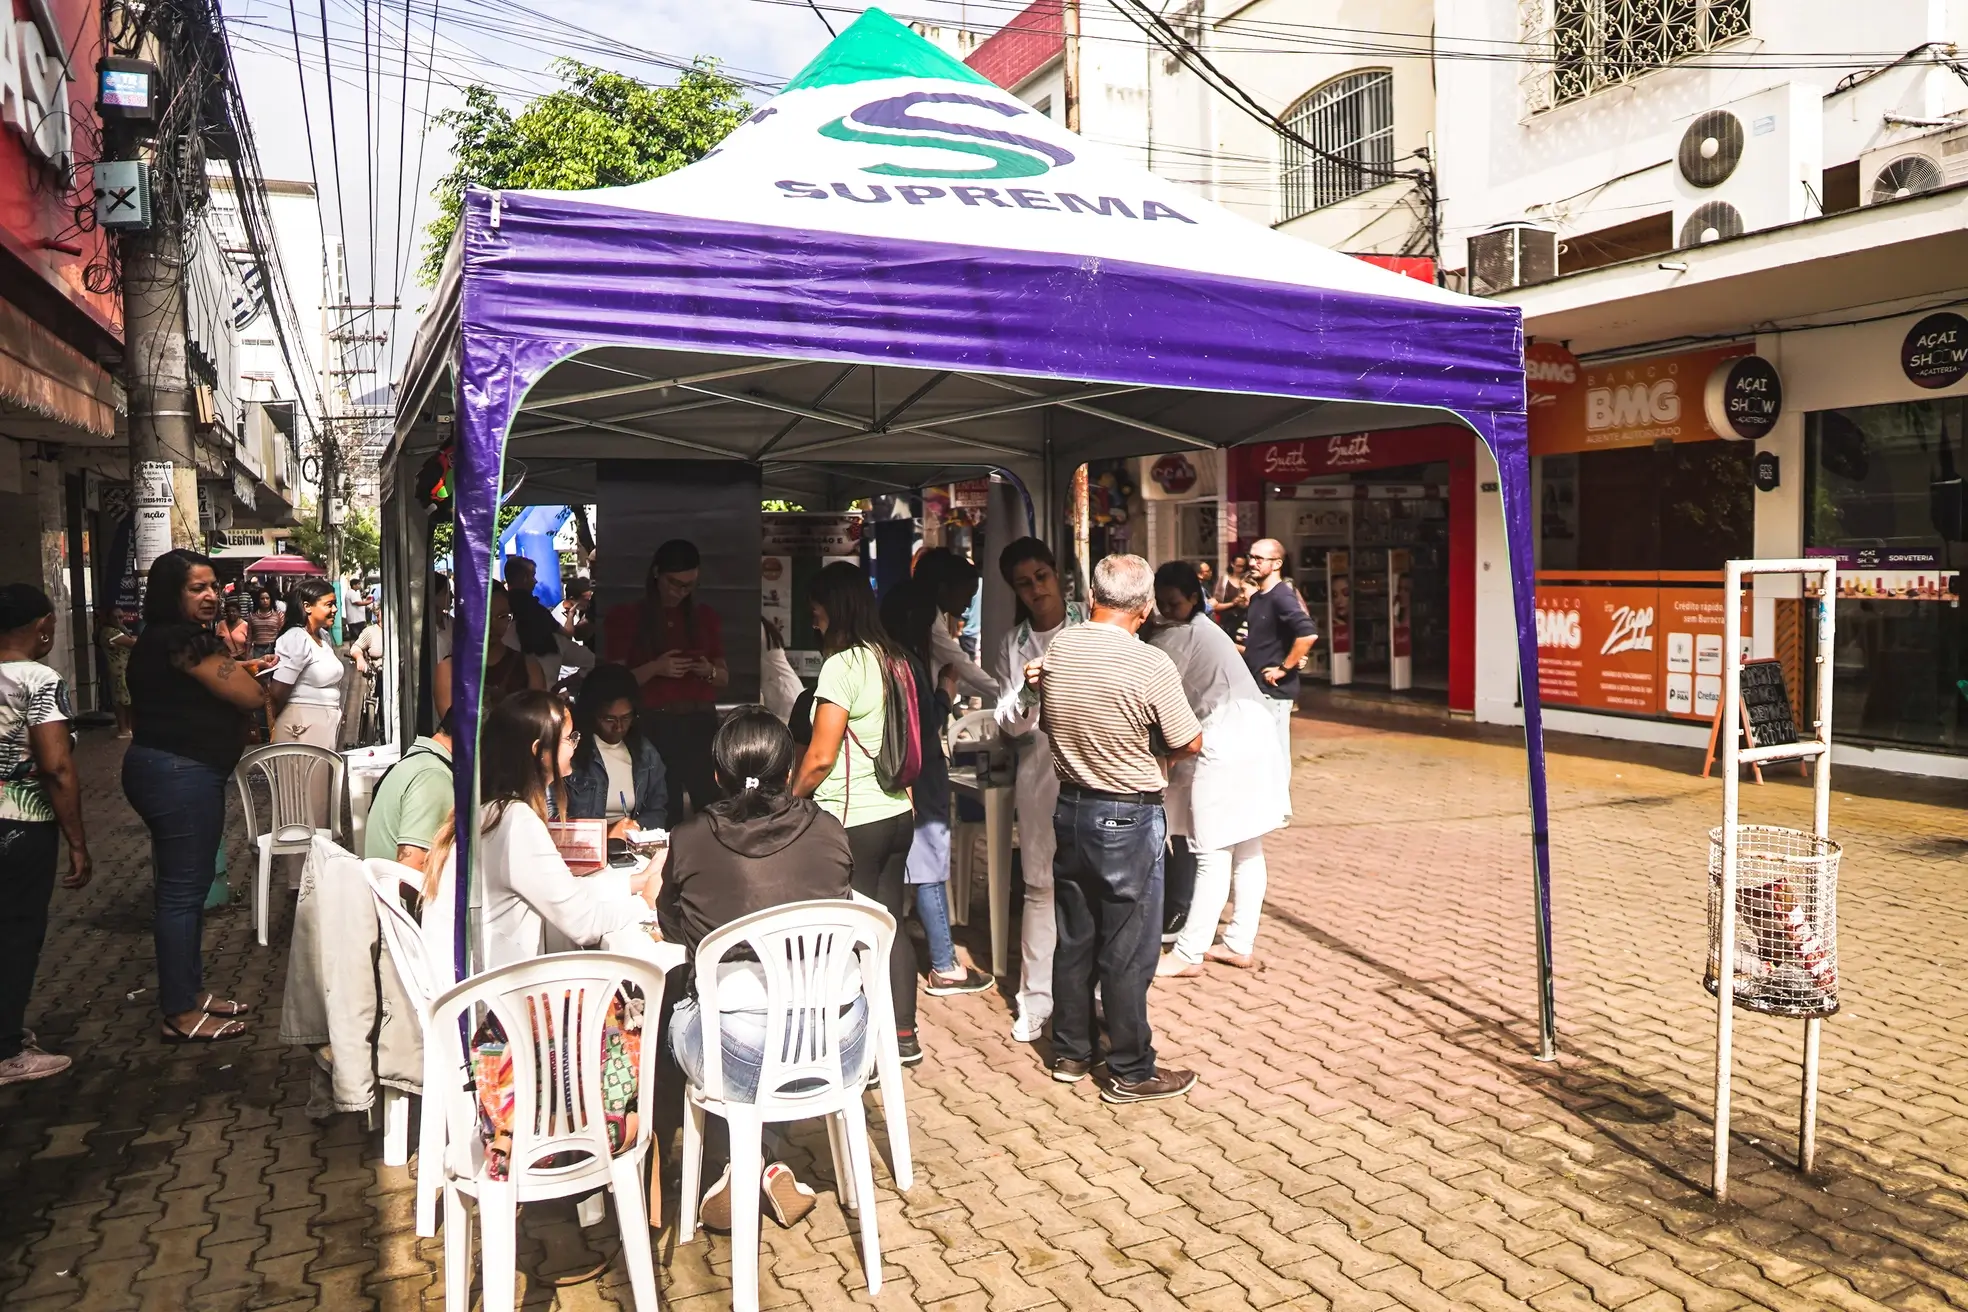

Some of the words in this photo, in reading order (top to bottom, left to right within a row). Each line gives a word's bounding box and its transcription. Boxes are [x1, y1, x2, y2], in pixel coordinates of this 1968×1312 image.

[774, 179, 1199, 224] SUPREMA
[1916, 330, 1957, 348] AÇAI
[1587, 363, 1679, 387] BANCO
[1736, 377, 1768, 393] AÇAI
[1587, 379, 1681, 431] BMG
[1586, 432, 1619, 444] AGENTE
[1621, 427, 1681, 439] AUTORIZADO
[228, 534, 265, 546] LEGÍTIMA
[1888, 554, 1934, 562] SORVETERIA
[1536, 598, 1580, 609] ANCO
[1674, 601, 1699, 610] Crédito
[1683, 615, 1698, 623] sem
[1698, 614, 1725, 625] Burocra
[1535, 609, 1582, 649] BMG
[1600, 606, 1654, 655] Zapp
[1677, 693, 1689, 701] PAN
[1697, 690, 1720, 701] Crefaz
